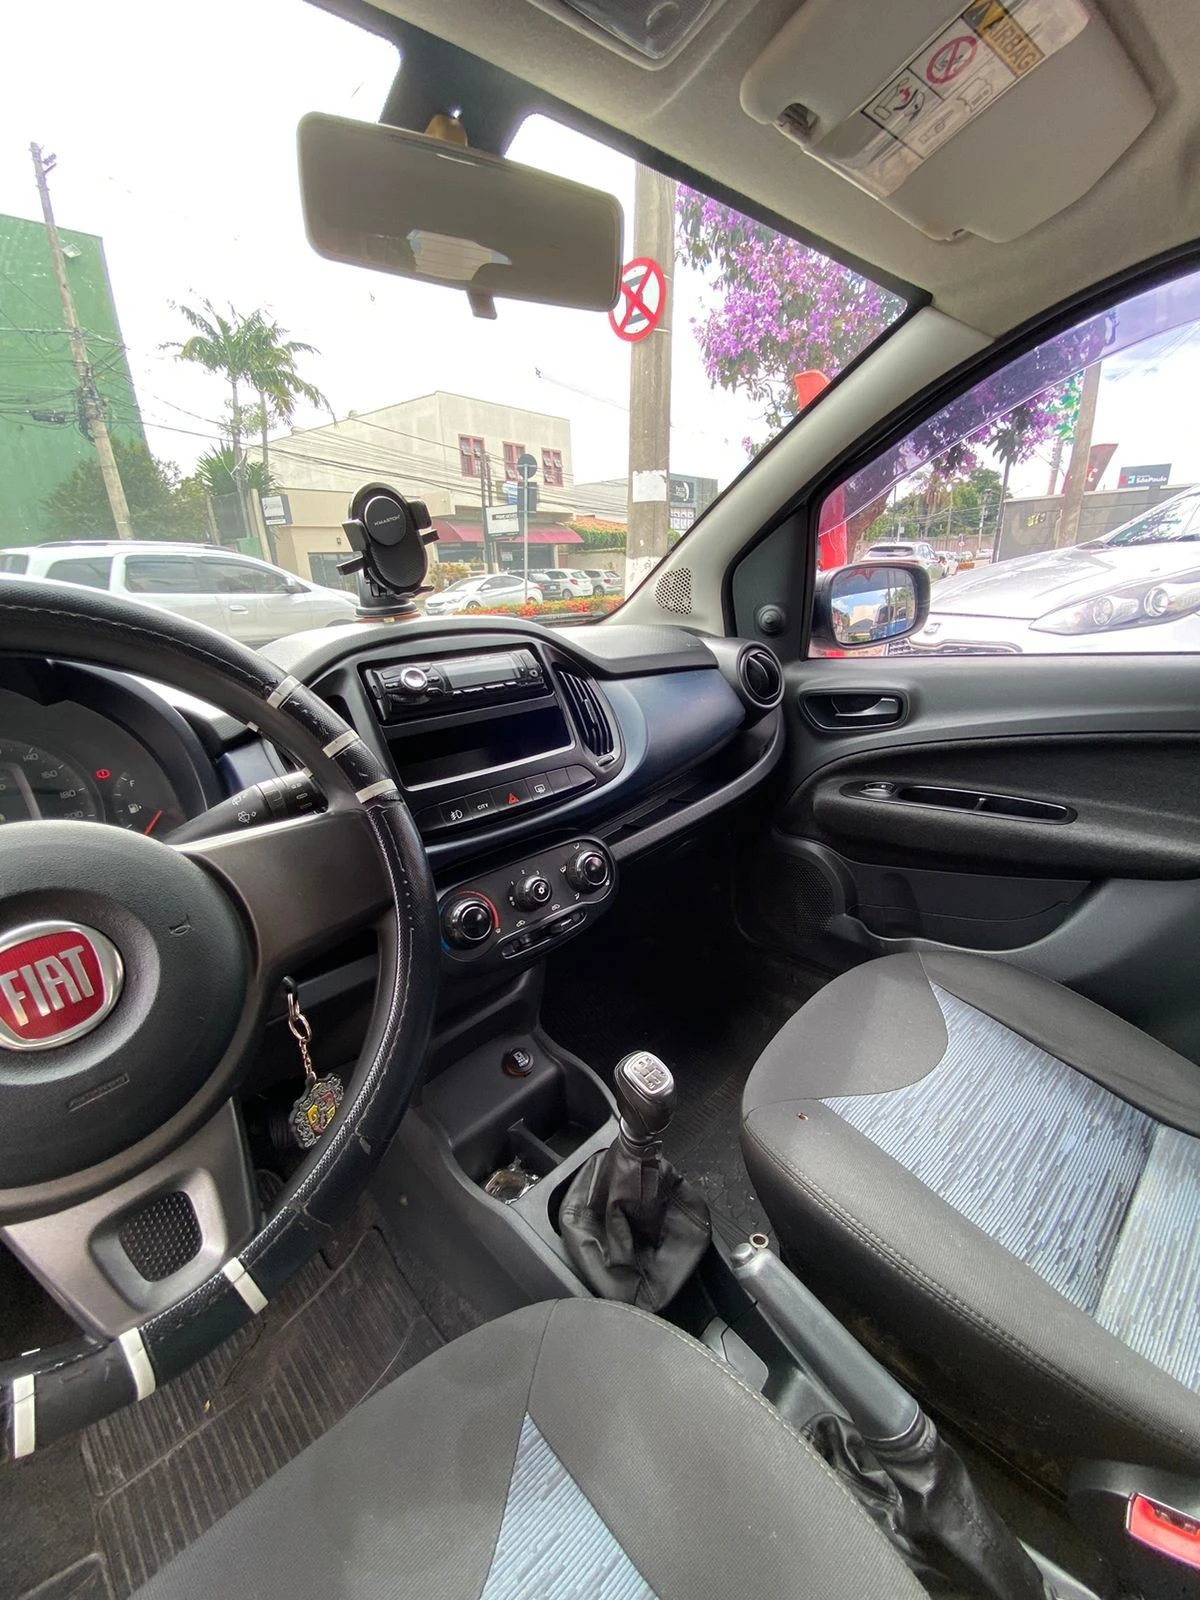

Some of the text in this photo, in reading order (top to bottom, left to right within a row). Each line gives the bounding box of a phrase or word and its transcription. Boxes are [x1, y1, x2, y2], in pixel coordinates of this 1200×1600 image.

[983, 16, 1036, 70] AIRBAG
[23, 753, 39, 762] 140
[60, 789, 76, 799] 180
[0, 945, 95, 1026] FIAT
